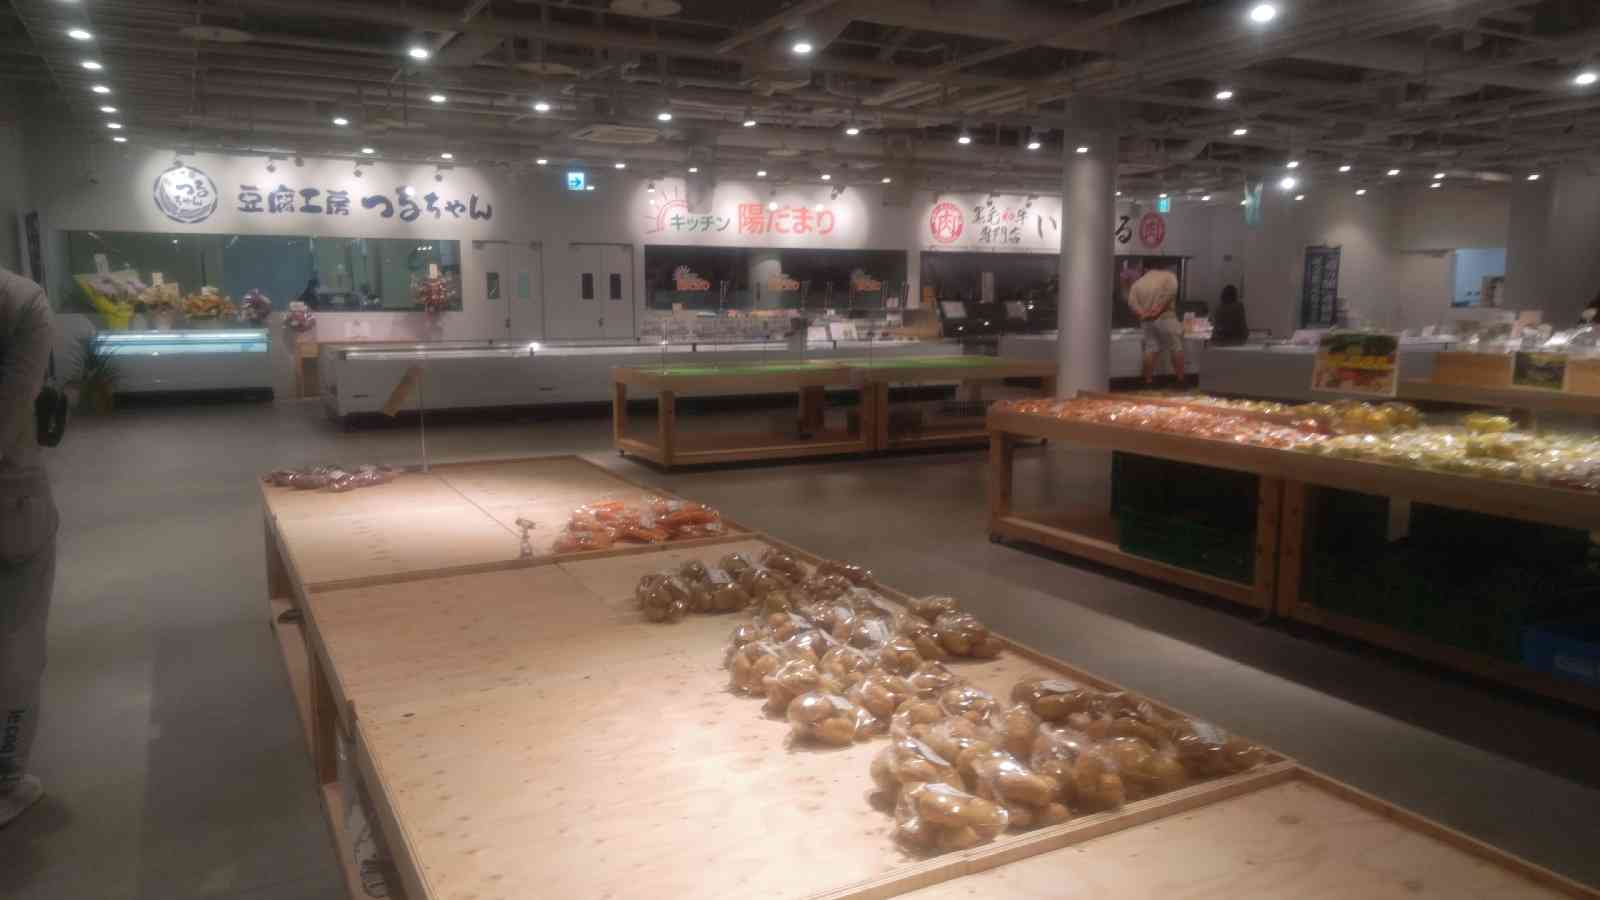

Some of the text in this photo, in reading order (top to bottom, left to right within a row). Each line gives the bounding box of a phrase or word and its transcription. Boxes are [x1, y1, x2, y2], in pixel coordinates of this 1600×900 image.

[237, 185, 493, 222] 豆腐工房 つるちゃん
[671, 202, 834, 234] キッチン 陽だまり
